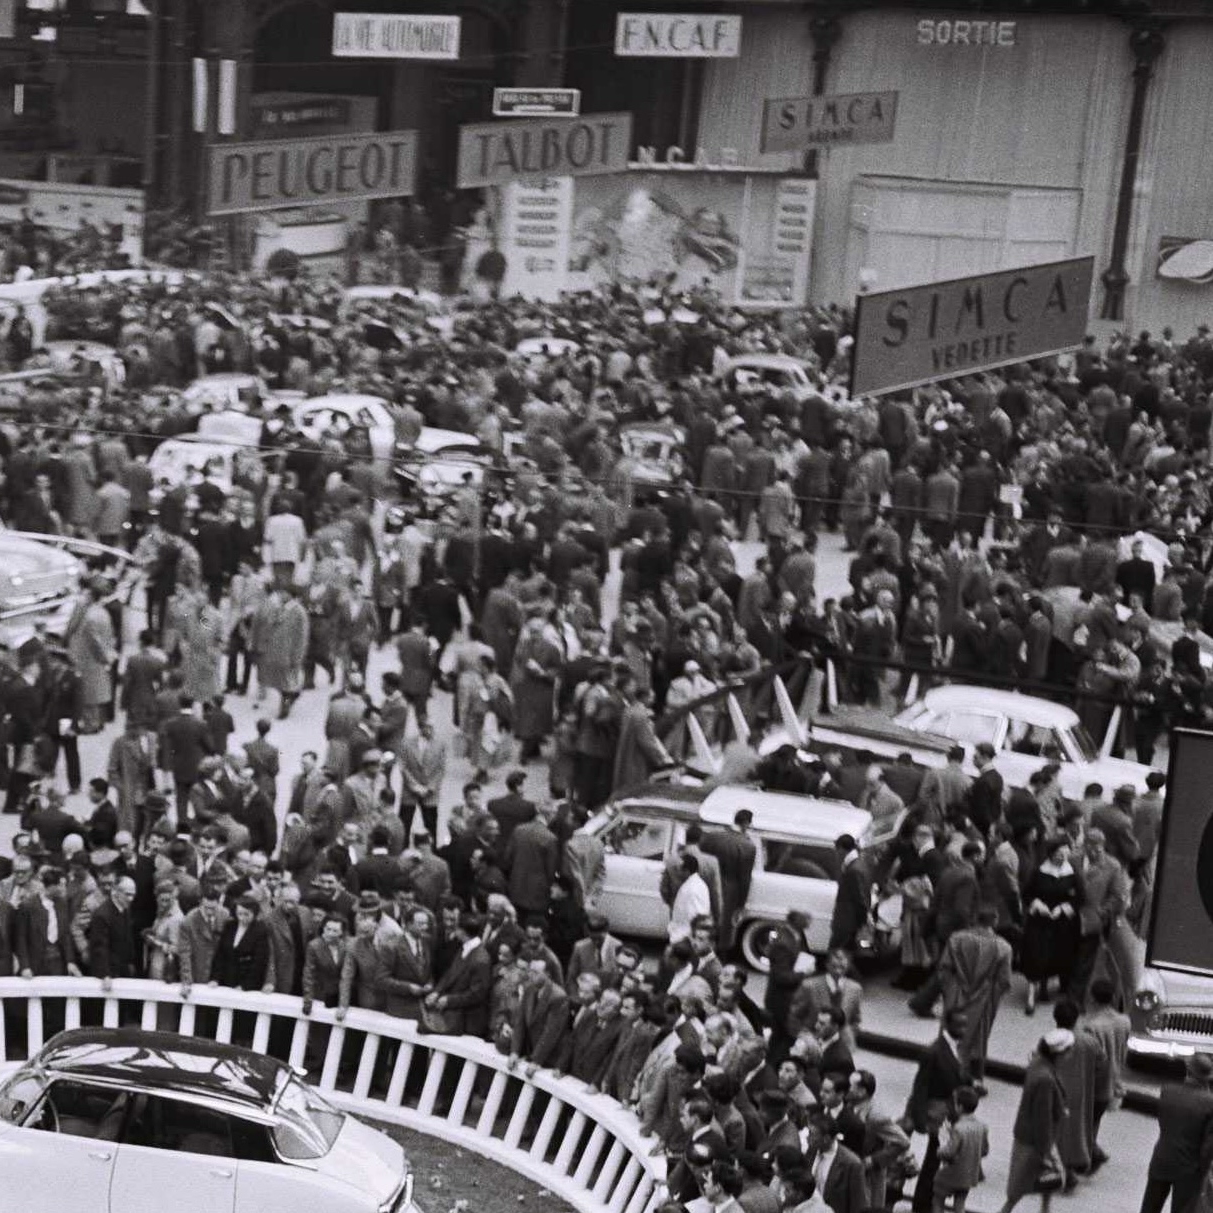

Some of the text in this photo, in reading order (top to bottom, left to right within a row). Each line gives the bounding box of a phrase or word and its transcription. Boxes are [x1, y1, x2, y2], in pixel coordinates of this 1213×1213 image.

[917, 19, 1017, 46] SORTIE
[778, 97, 885, 131] SIMCA
[221, 141, 409, 201] PEUGEOT
[476, 121, 618, 173] TALBOT
[883, 273, 1067, 348] SIMCA
